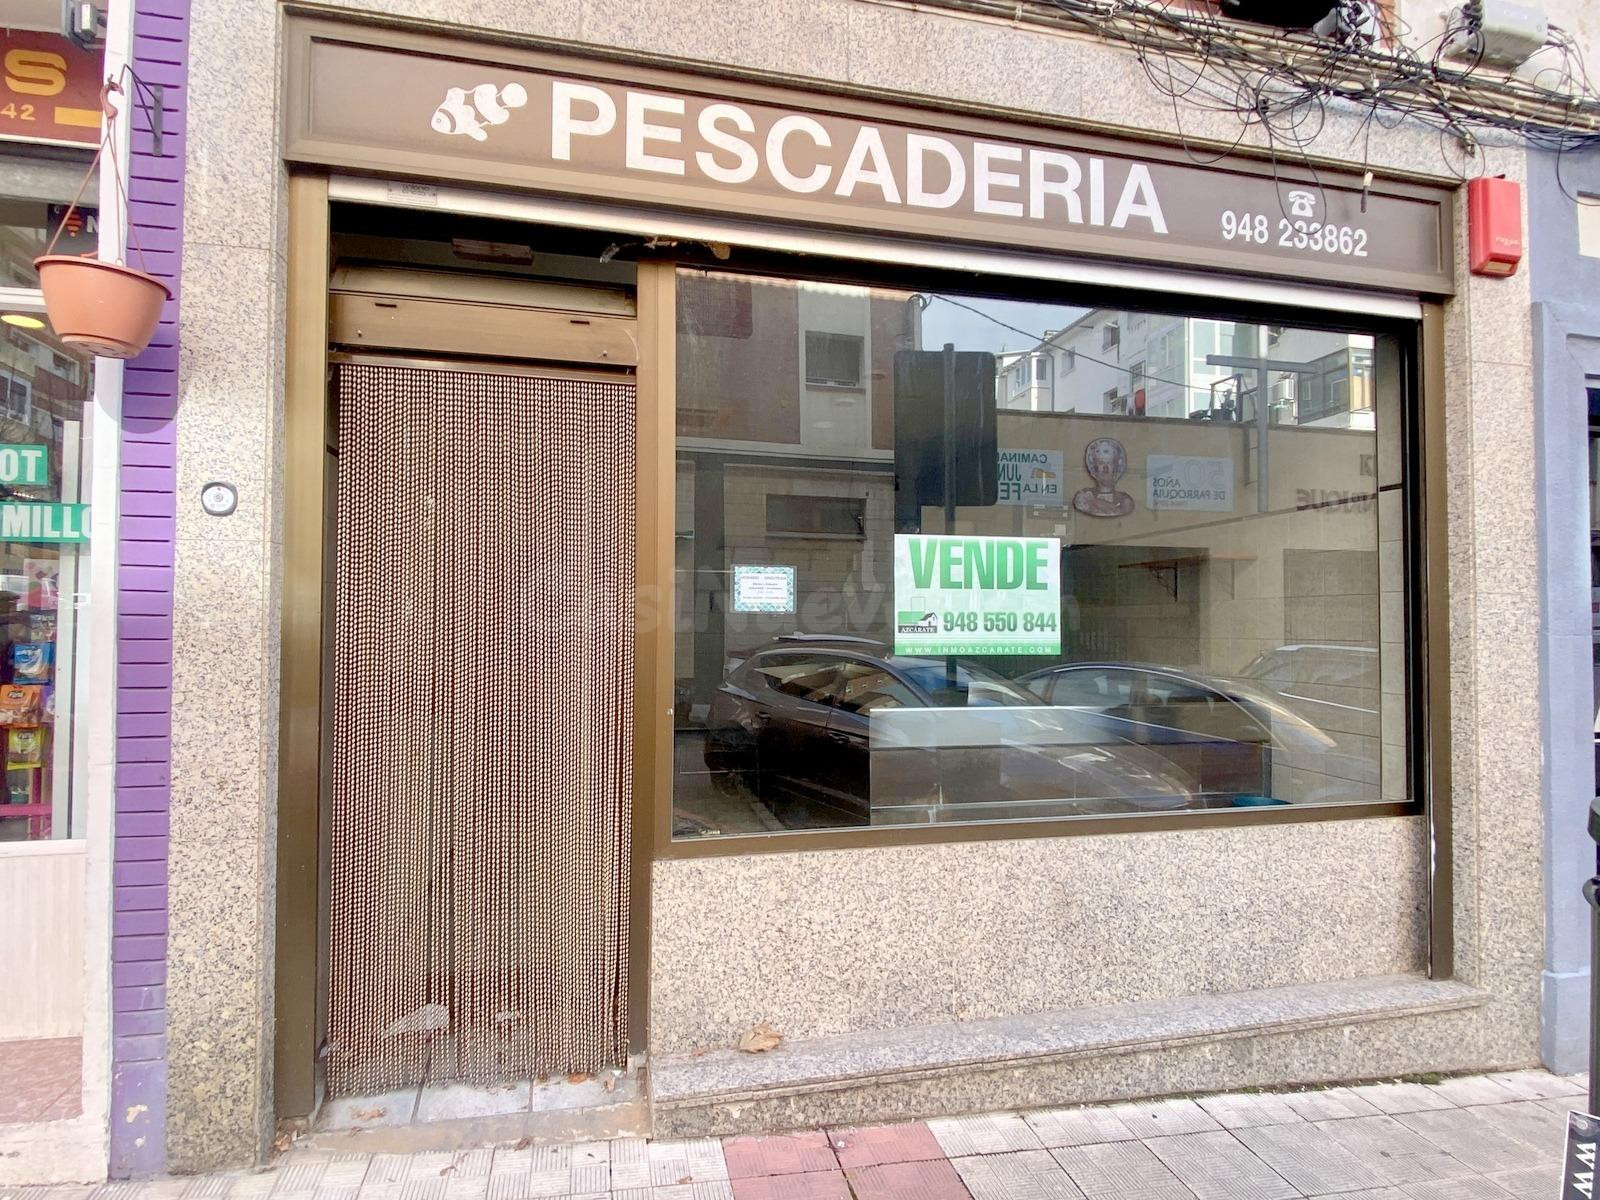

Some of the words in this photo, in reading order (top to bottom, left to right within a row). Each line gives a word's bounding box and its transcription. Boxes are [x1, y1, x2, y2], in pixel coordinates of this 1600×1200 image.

[550, 80, 1168, 234] PESCADERIA
[1221, 210, 1269, 244] 948
[1278, 217, 1368, 257] 233862
[0, 448, 43, 482] OT
[908, 537, 1048, 590] VENDE
[943, 611, 978, 632] 948
[983, 611, 1018, 632] 550
[1023, 611, 1057, 632] 844
